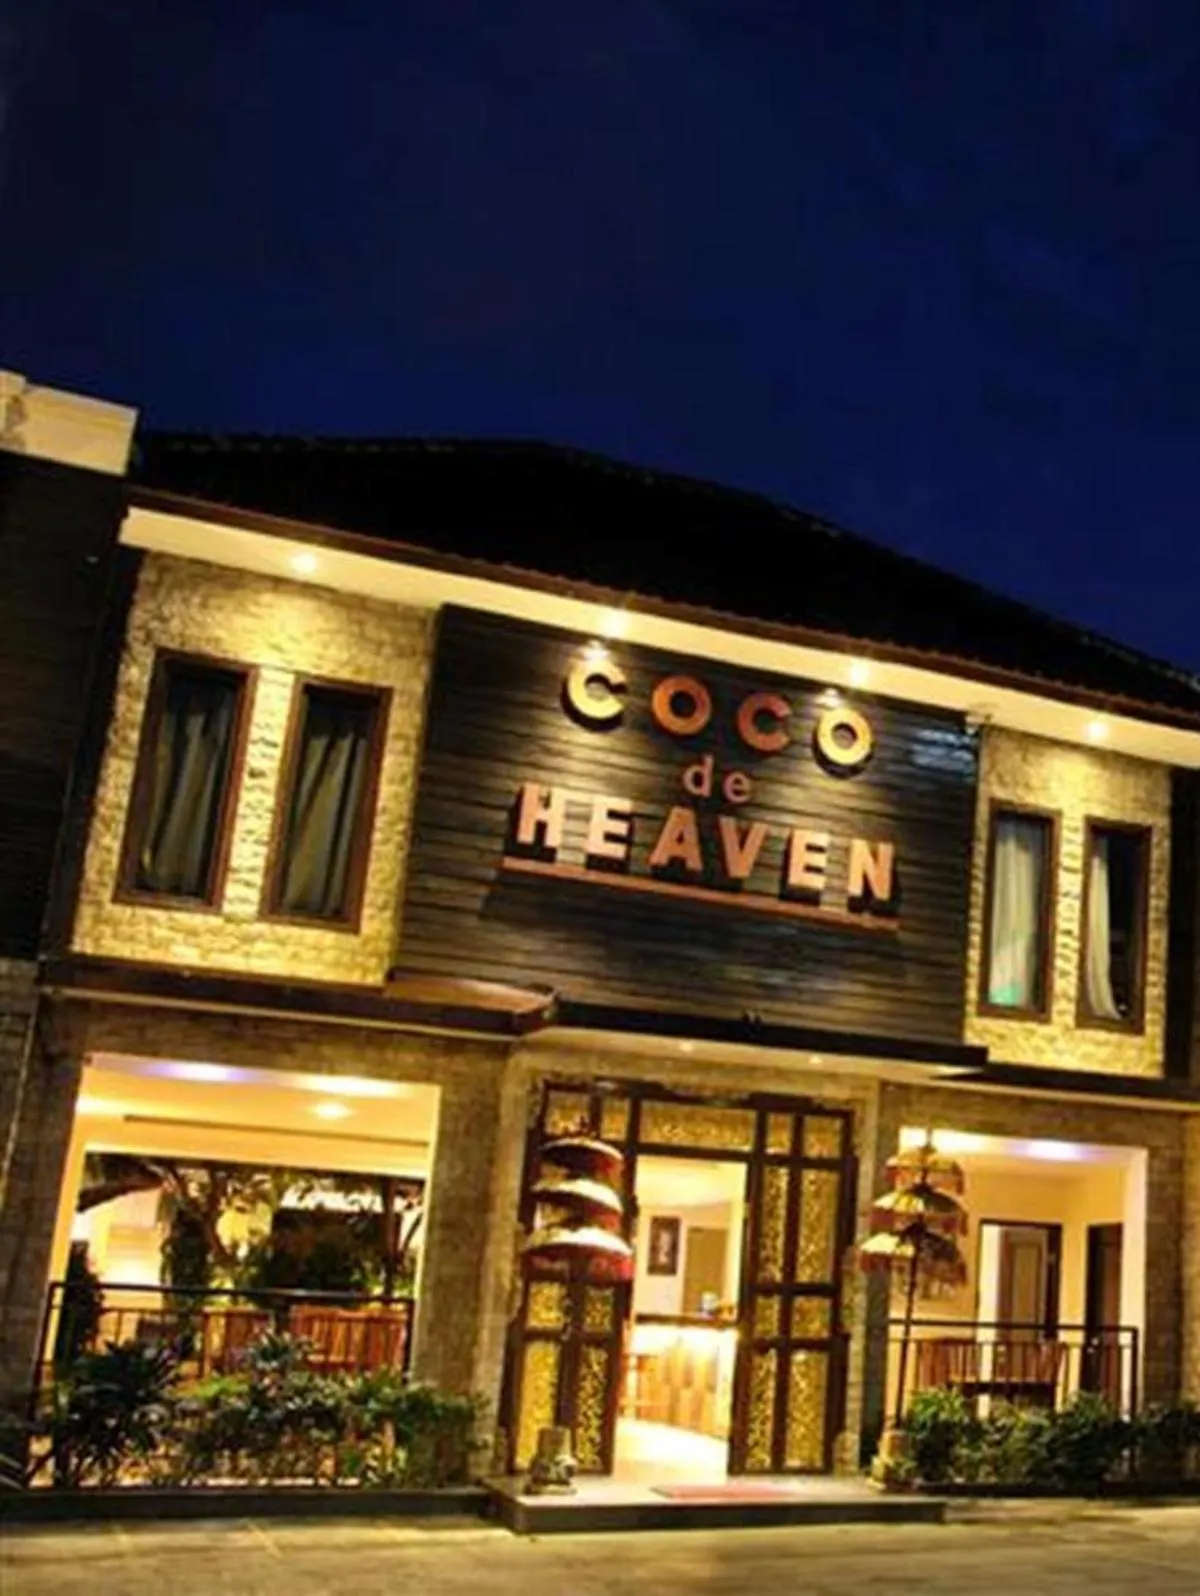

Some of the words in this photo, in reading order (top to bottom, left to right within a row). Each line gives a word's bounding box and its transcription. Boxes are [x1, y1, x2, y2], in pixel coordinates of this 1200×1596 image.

[566, 656, 873, 767] COCO
[682, 754, 753, 803] de
[516, 781, 894, 900] HEAVEN
